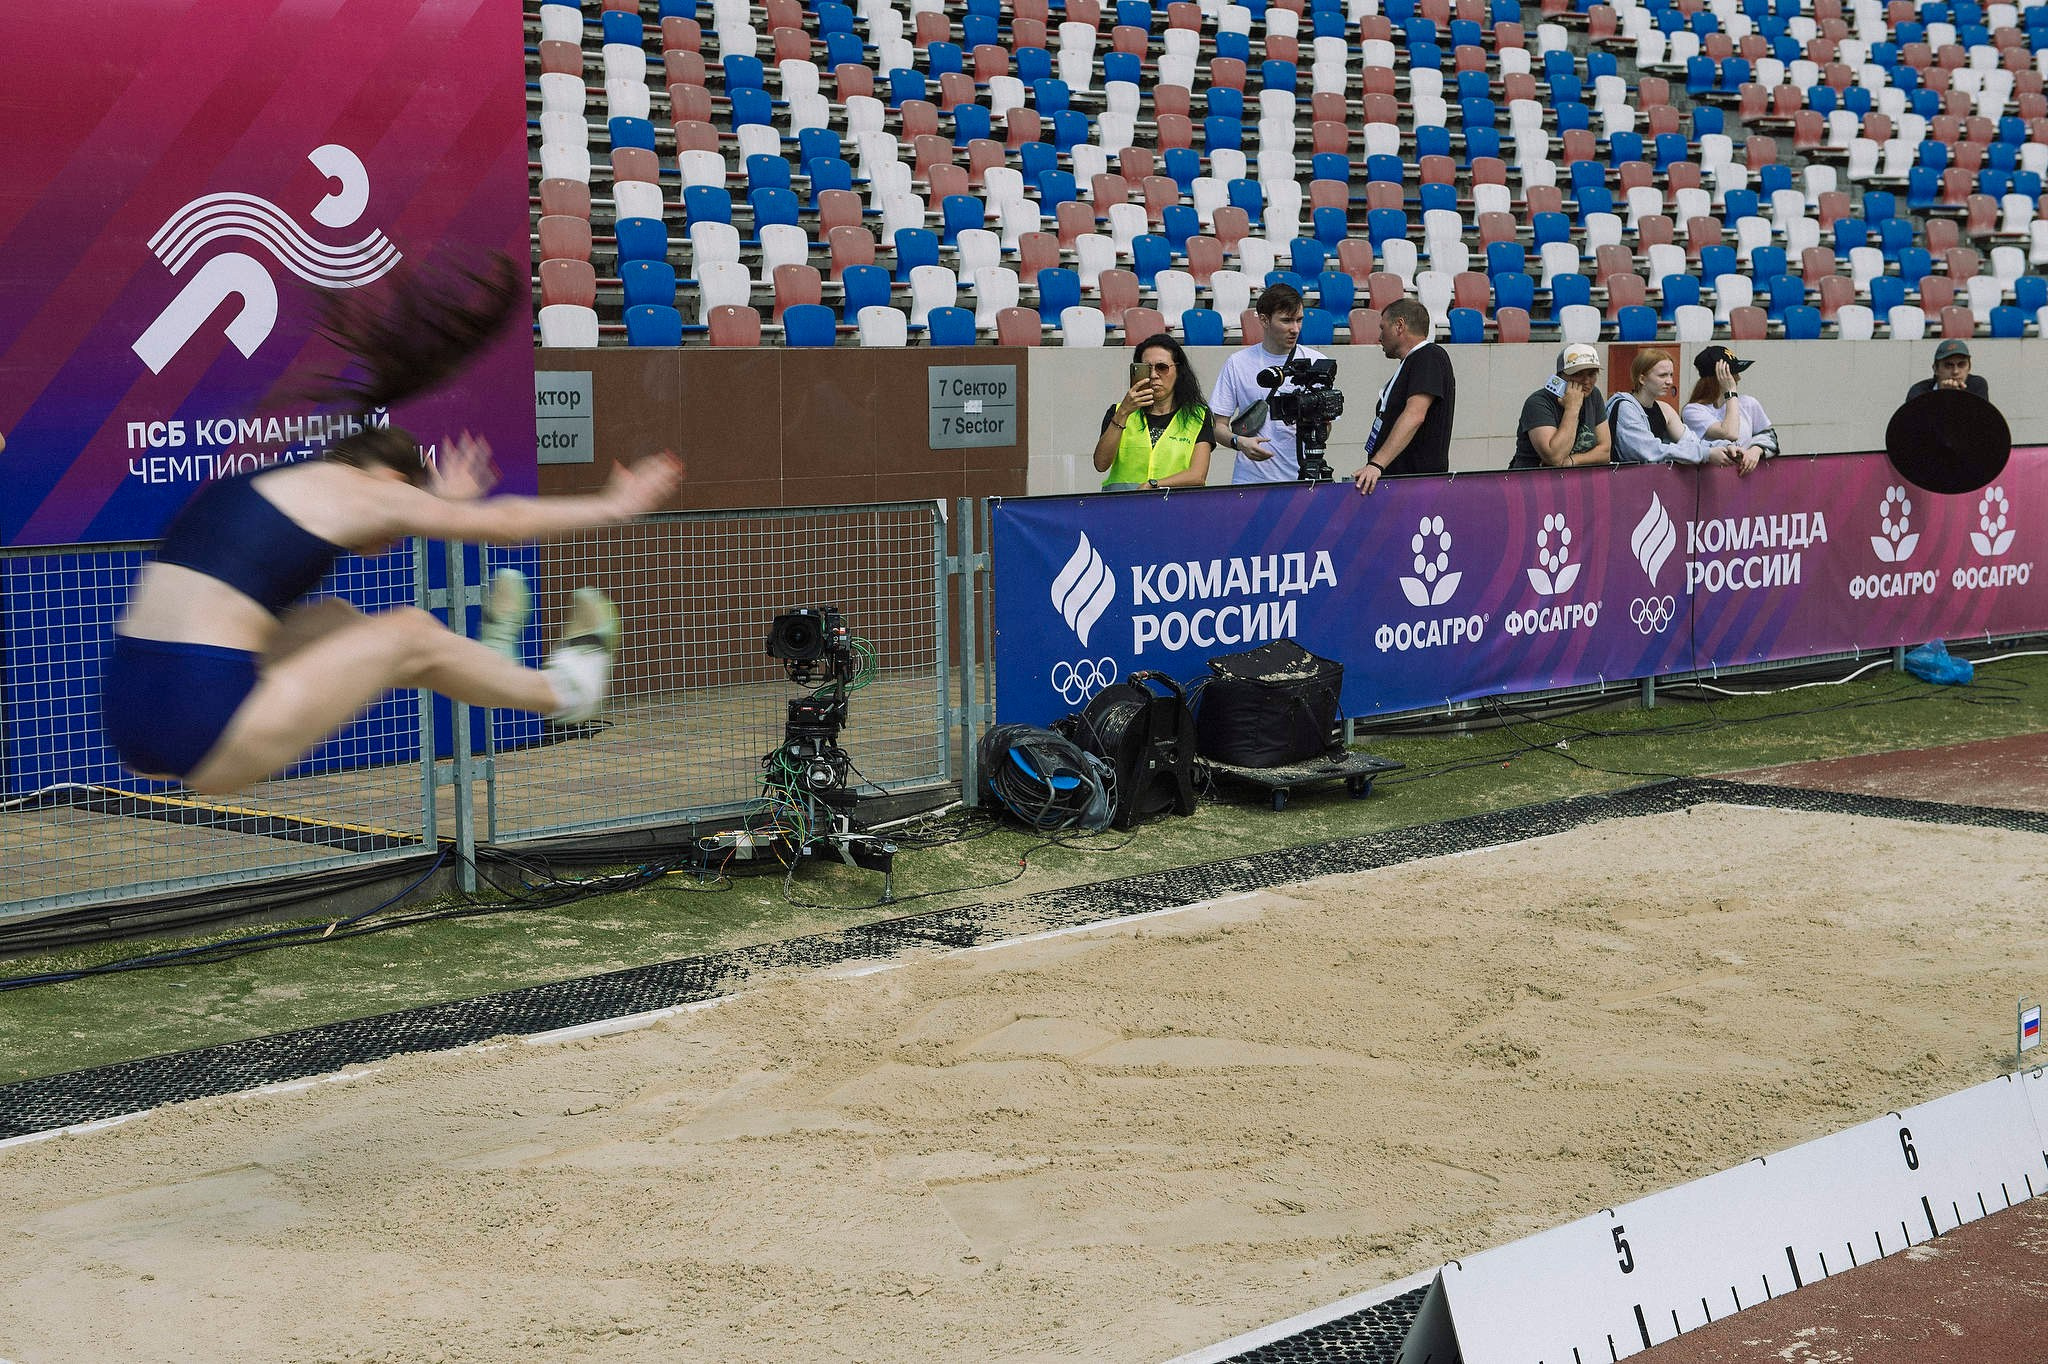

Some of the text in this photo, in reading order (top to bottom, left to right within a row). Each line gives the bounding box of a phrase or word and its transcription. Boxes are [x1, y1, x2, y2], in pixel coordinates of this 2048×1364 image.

[536, 390, 581, 410] ктор
[938, 378, 1008, 399] 7 Сектор
[126, 406, 390, 449] ПСБ КОМАНДНЫЙ
[942, 416, 1005, 435] 7 Sector
[1686, 511, 1828, 554] КОМАНДА
[1130, 550, 1338, 606] КОМАНДА
[1686, 552, 1801, 595] РОССИИ
[1131, 599, 1297, 655] РОССИИ
[1899, 1127, 1919, 1171] 6
[1611, 1225, 1635, 1274] 5
